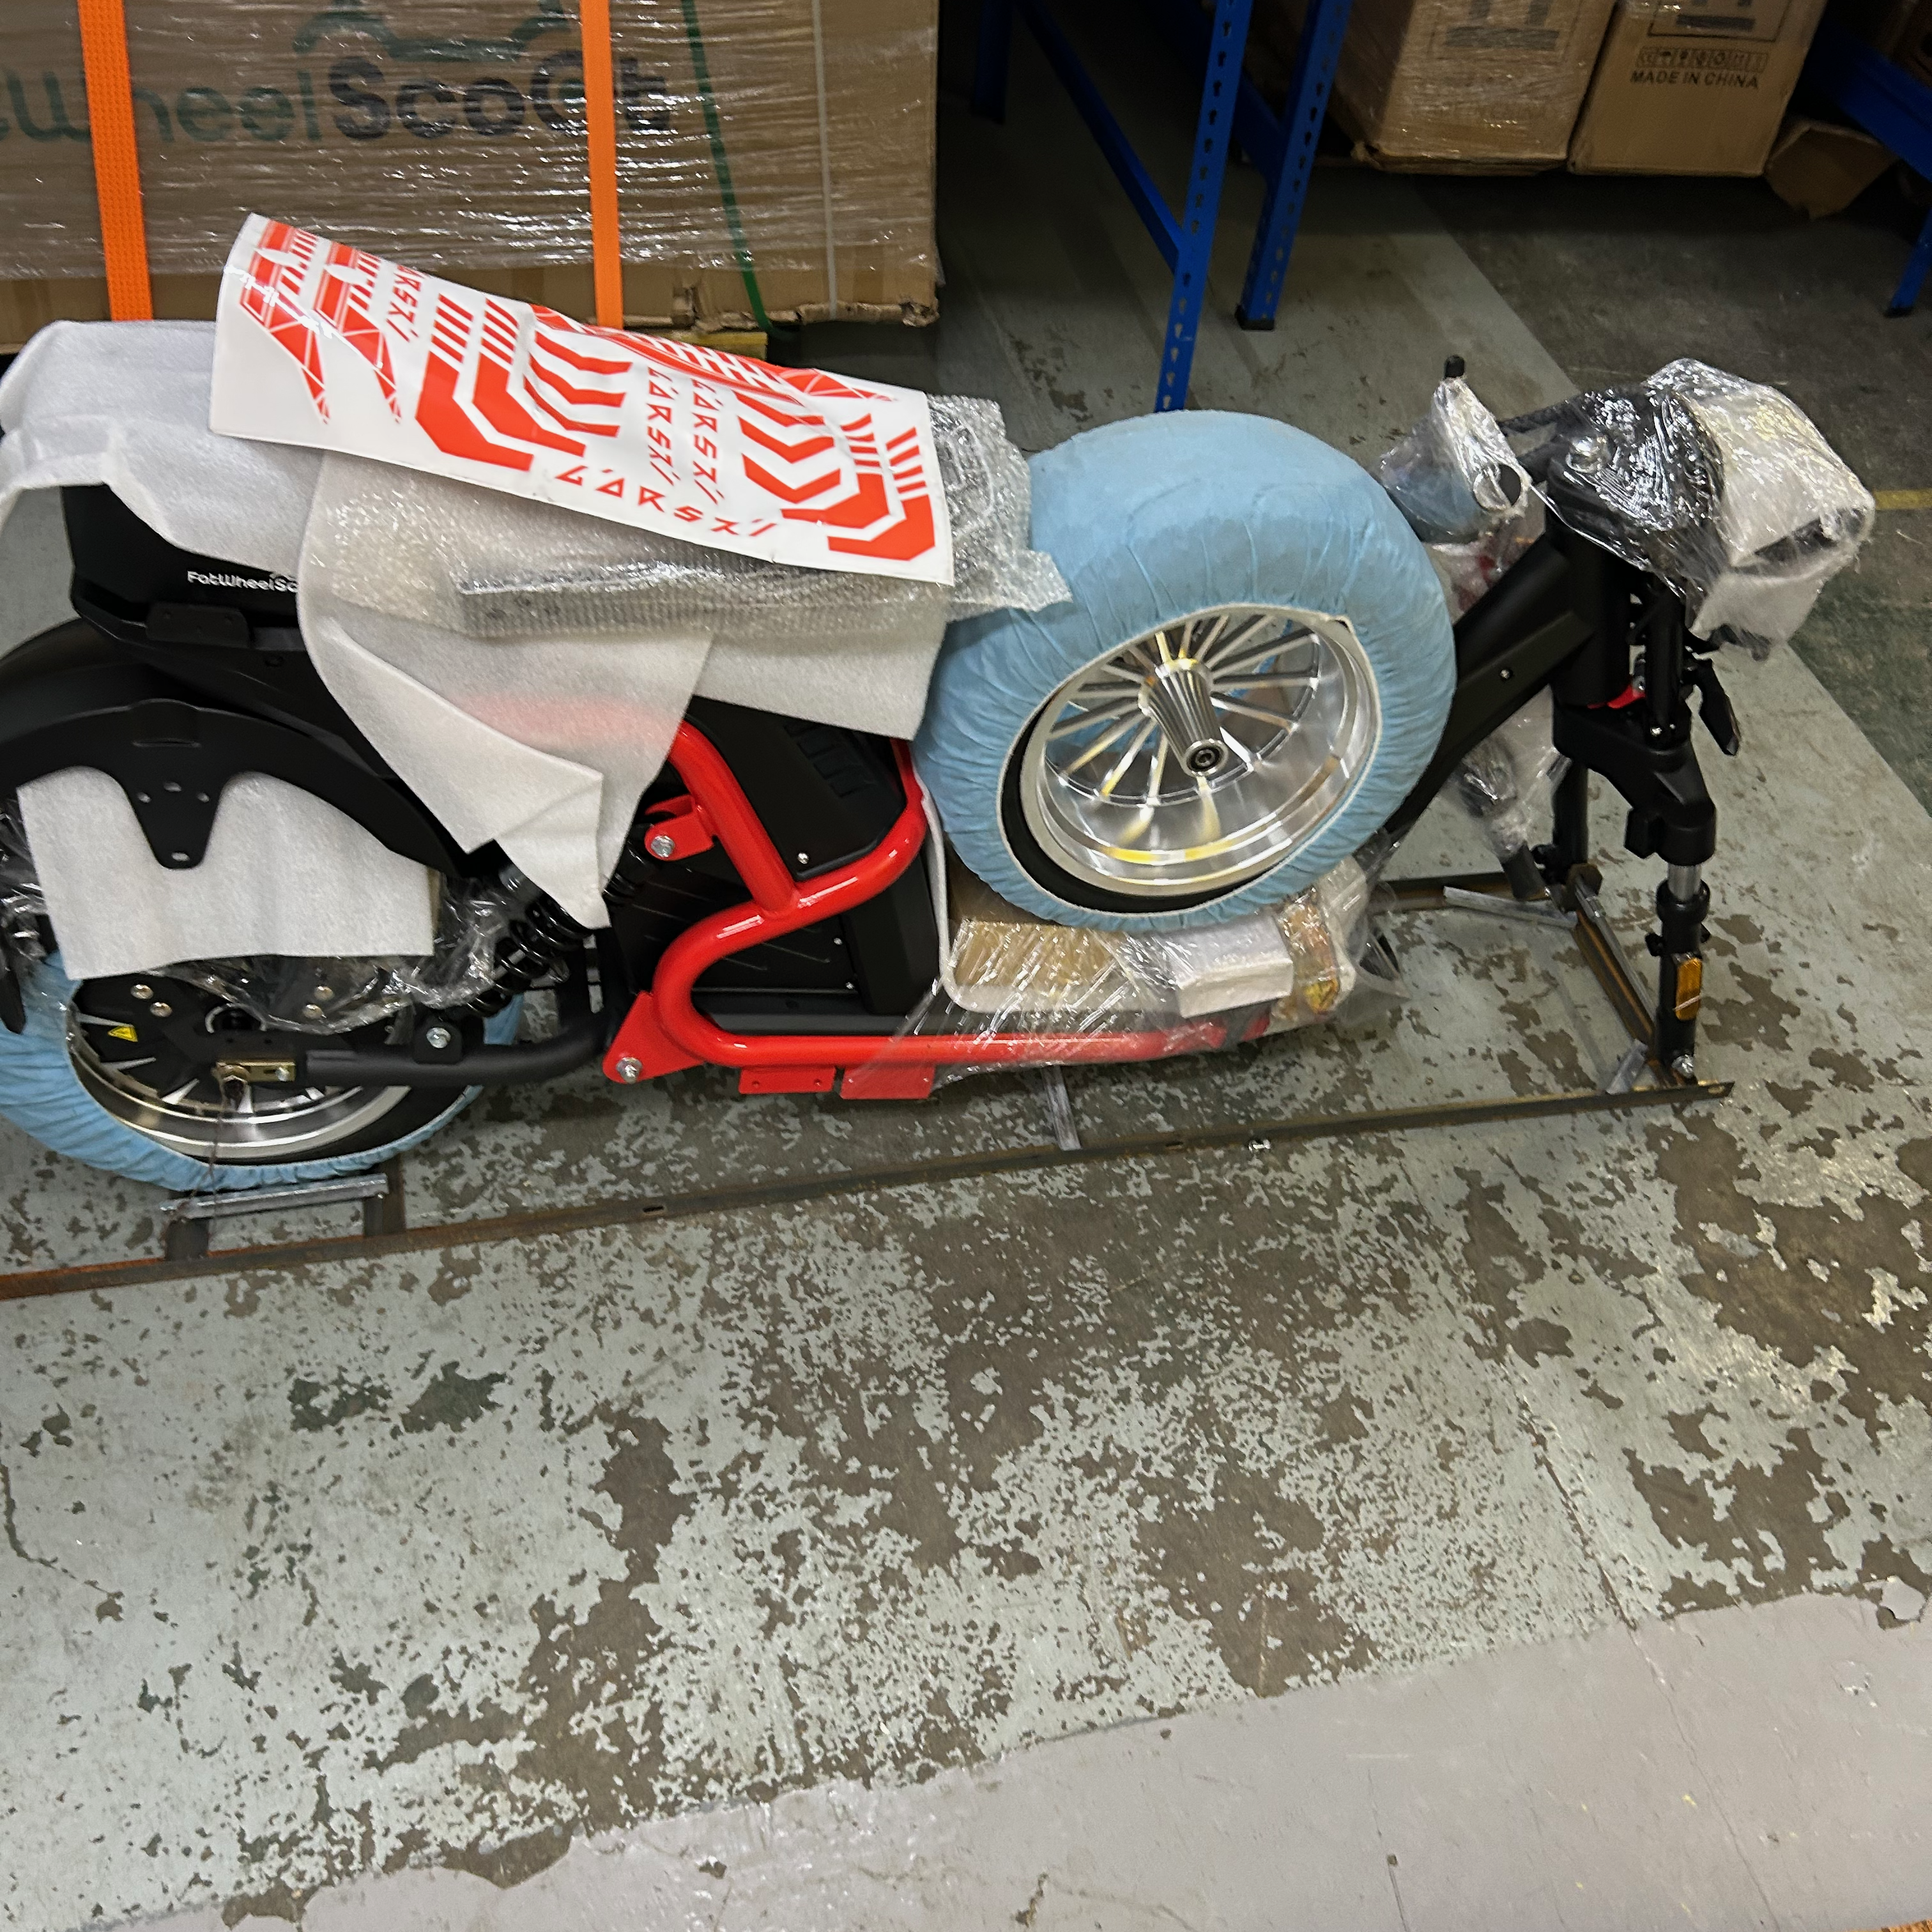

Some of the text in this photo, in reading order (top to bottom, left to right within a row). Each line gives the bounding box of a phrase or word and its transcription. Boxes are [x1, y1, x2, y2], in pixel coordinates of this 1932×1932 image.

[1630, 70, 1758, 88] MADE IN CHINA
